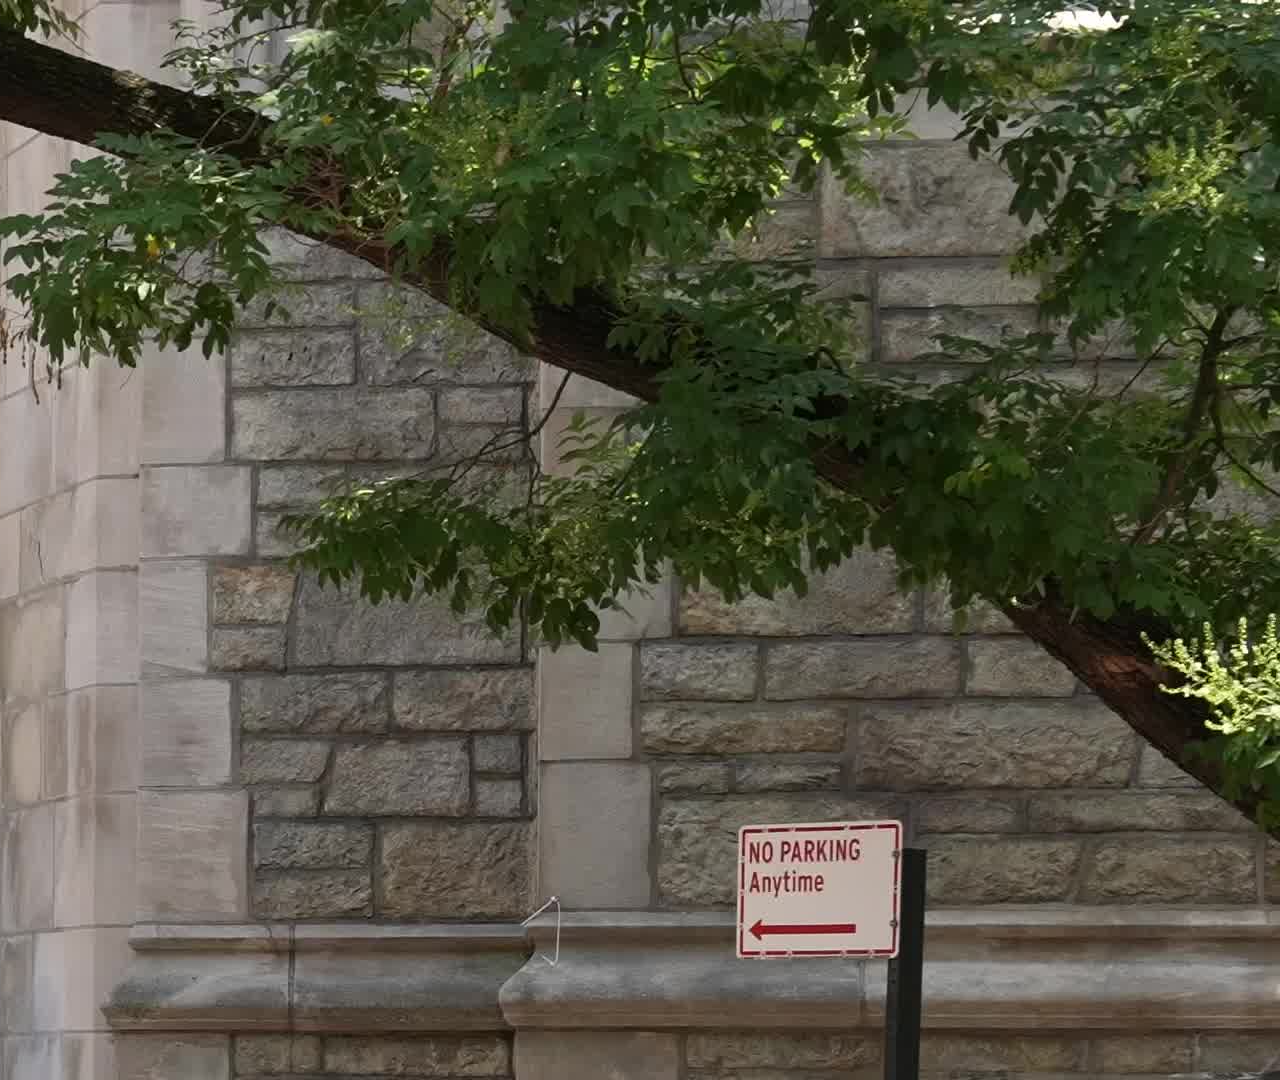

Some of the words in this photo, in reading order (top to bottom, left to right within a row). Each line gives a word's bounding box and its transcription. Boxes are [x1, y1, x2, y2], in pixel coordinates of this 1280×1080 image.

[749, 841, 774, 863] NO
[780, 838, 861, 862] PARKING
[749, 869, 824, 898] Anytime
